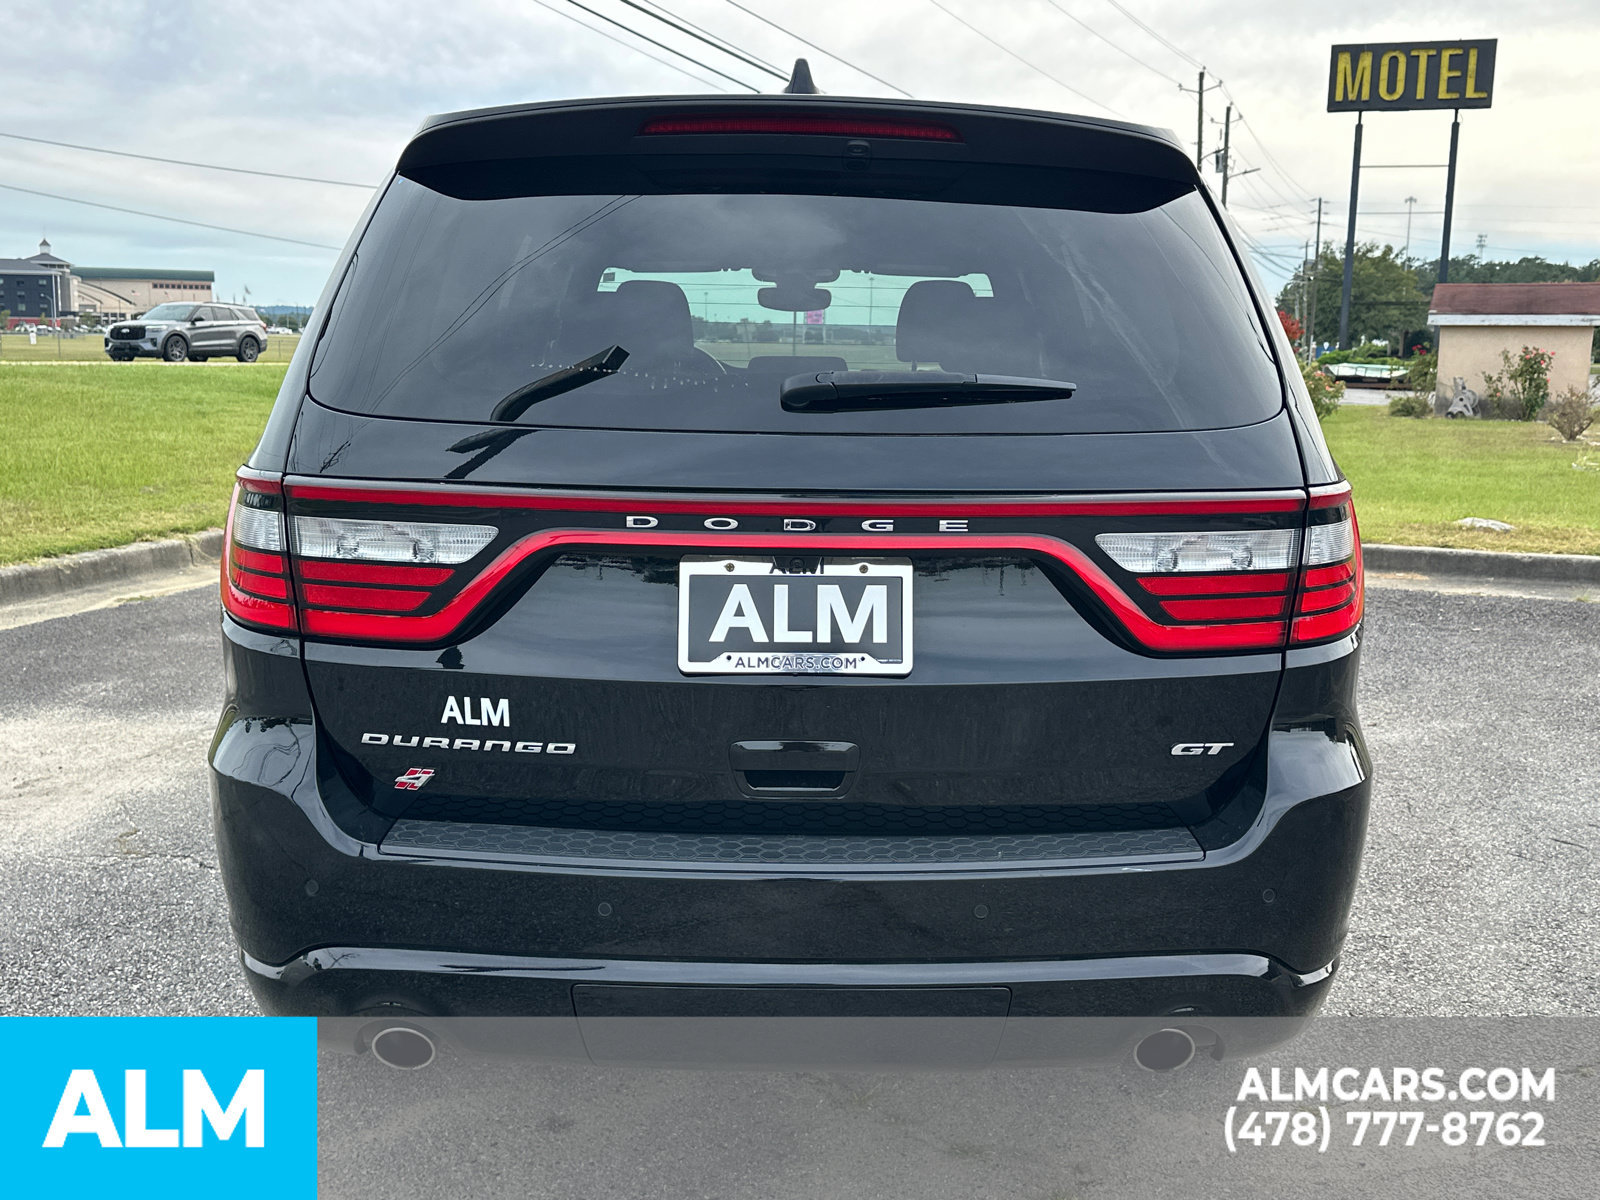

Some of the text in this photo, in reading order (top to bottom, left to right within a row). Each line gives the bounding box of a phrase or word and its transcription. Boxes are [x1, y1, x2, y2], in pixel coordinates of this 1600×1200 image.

[1335, 48, 1488, 101] MOTEL
[625, 515, 969, 532] DODGE
[708, 583, 888, 644] ALM
[734, 656, 857, 669] ALMCARS.COM
[440, 695, 510, 727] ALM
[361, 732, 577, 755] DURANGO
[1171, 742, 1235, 756] GT
